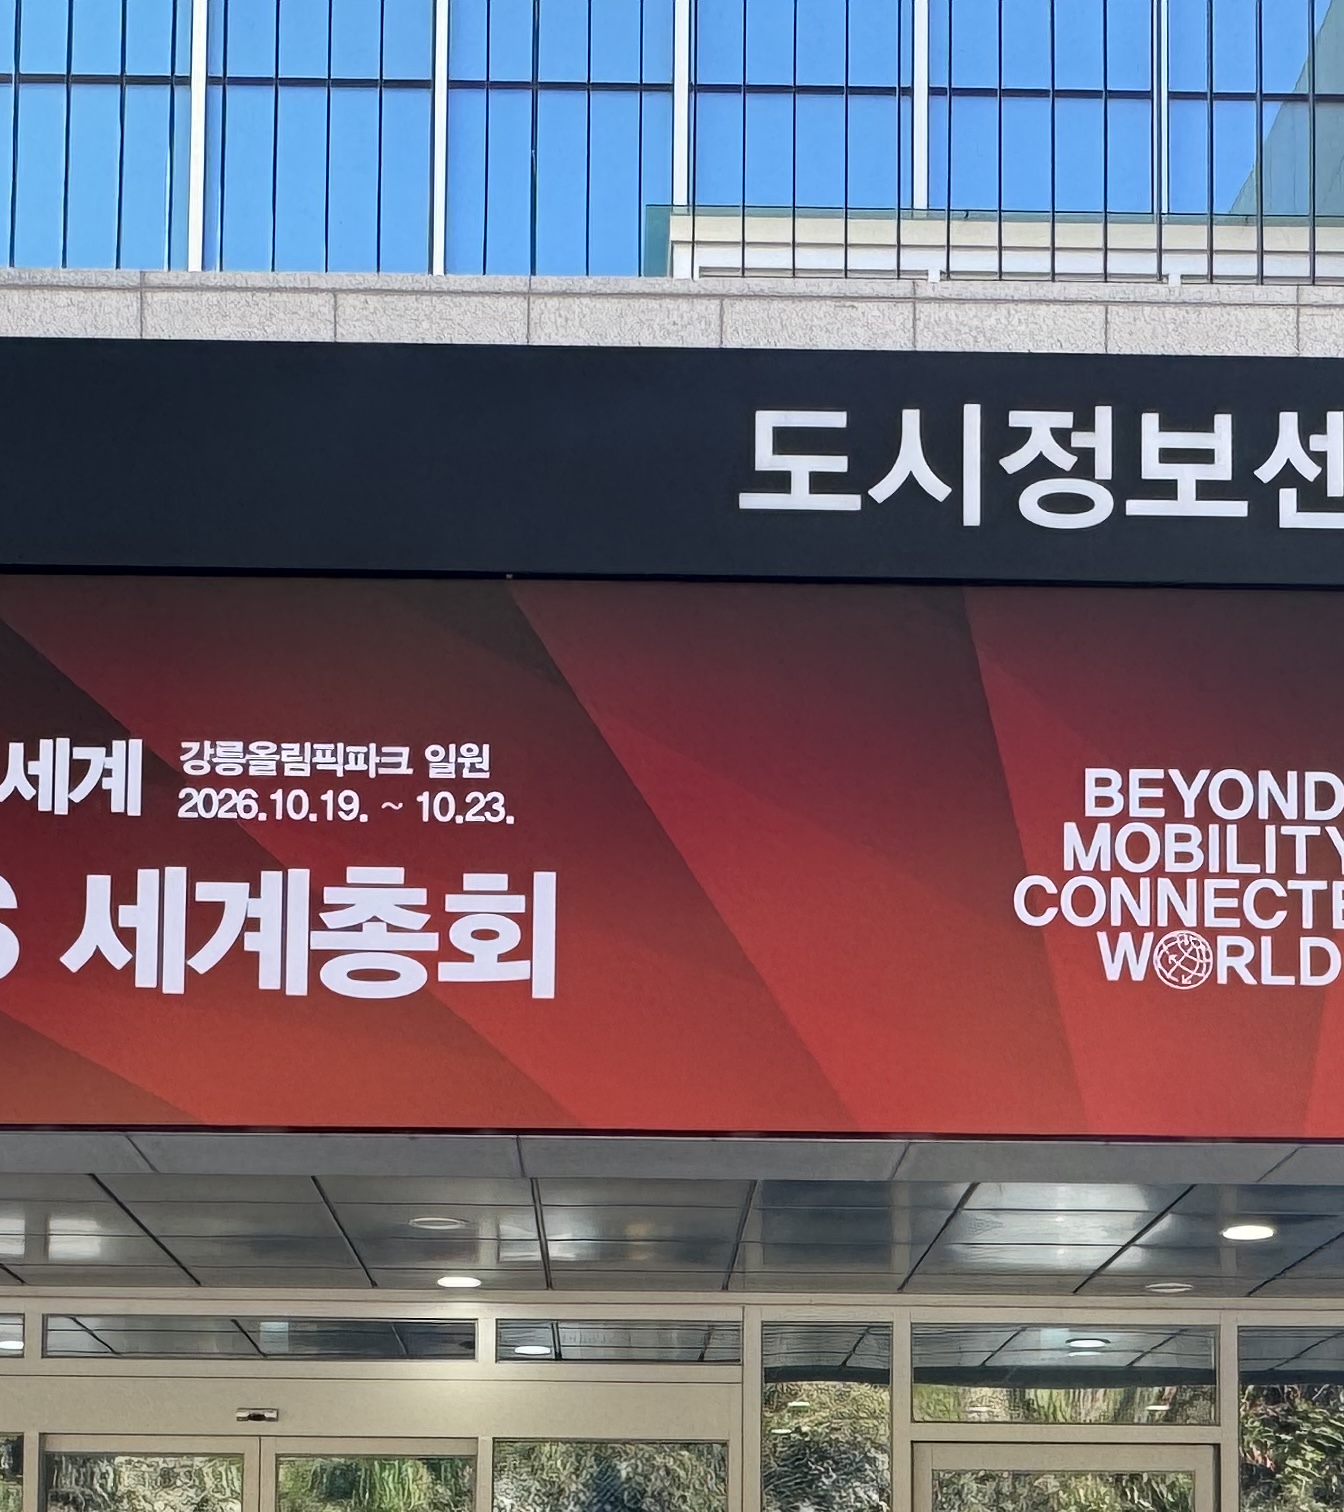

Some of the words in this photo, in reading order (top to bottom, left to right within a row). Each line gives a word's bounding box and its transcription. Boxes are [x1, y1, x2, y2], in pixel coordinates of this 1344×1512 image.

[179, 740, 414, 779] 강릉올림픽파크
[424, 742, 491, 779] 일원
[177, 787, 369, 823] 2026.10.19.
[416, 790, 515, 825] 10.23.
[59, 866, 557, 999] 세계총회
